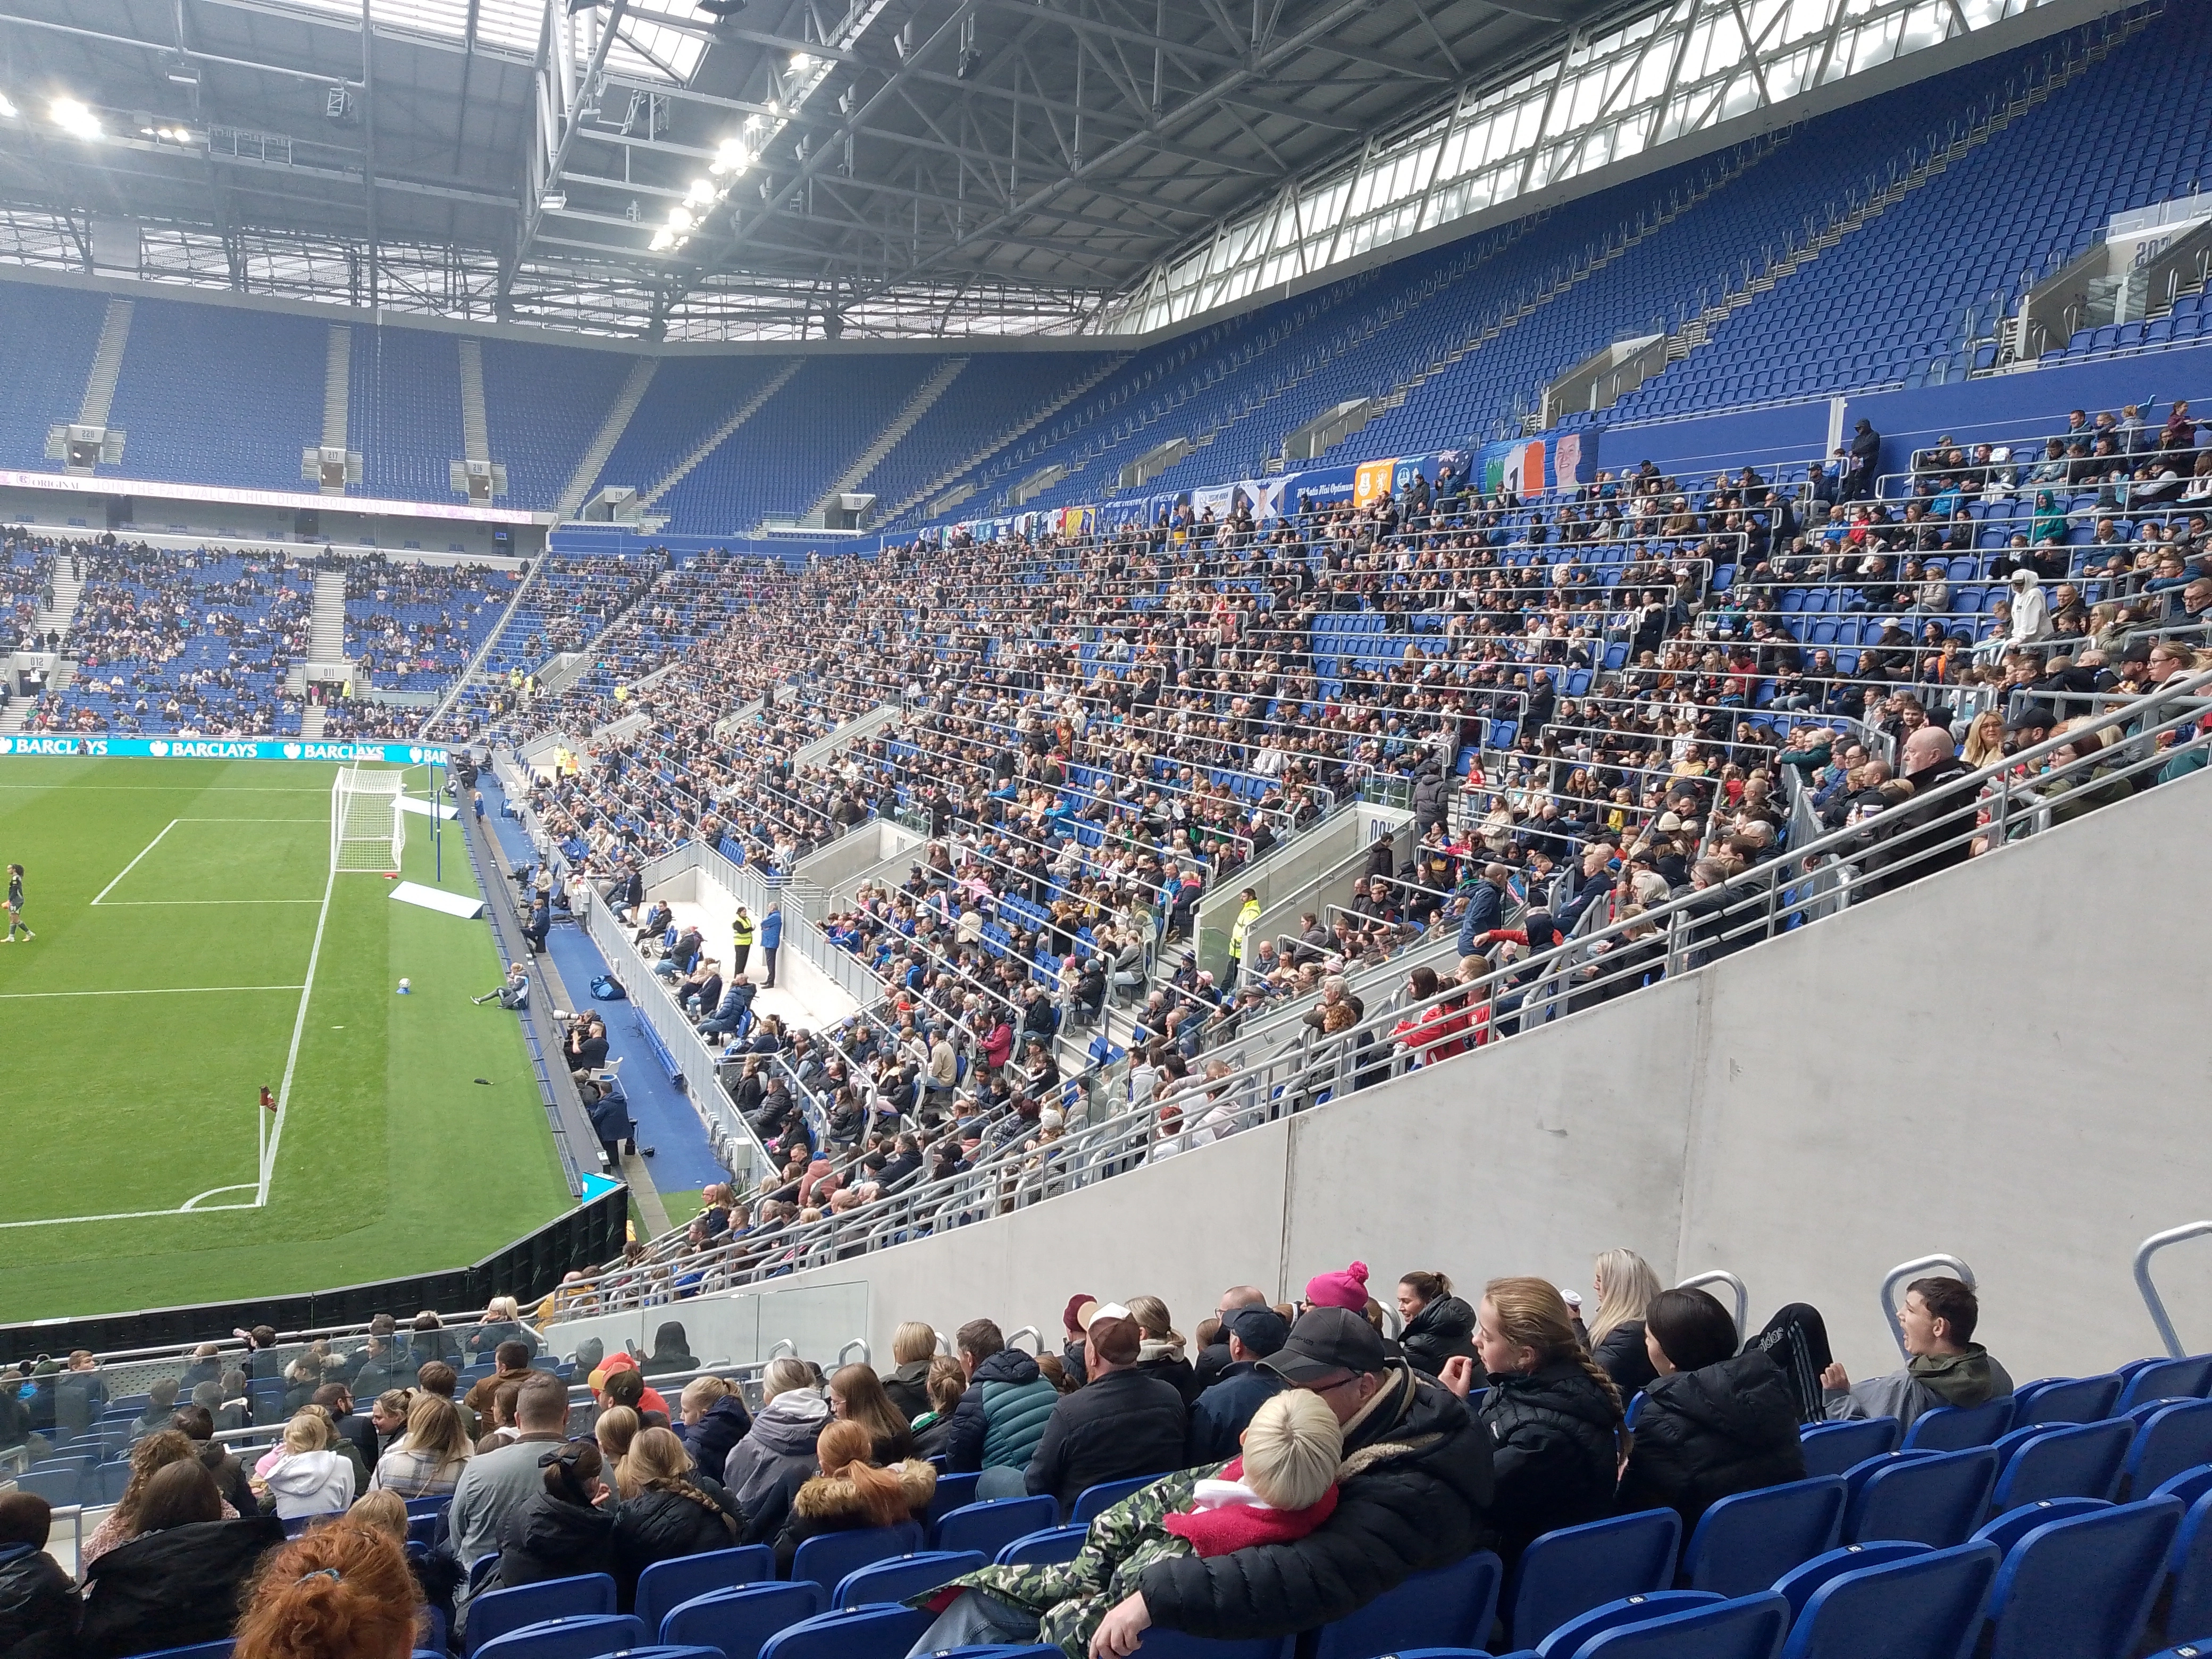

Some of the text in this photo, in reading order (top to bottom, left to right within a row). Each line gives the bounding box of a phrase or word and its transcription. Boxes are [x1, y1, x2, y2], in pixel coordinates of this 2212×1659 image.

[1319, 483, 1330, 496] Nisi
[1330, 482, 1354, 496] Optimum
[93, 481, 405, 513] JOIN THE FAN WALL AT HILL DICKINSON STADIUM
[30, 657, 44, 666] 012
[324, 668, 334, 677] 011
[172, 743, 257, 758] BARCLAYS
